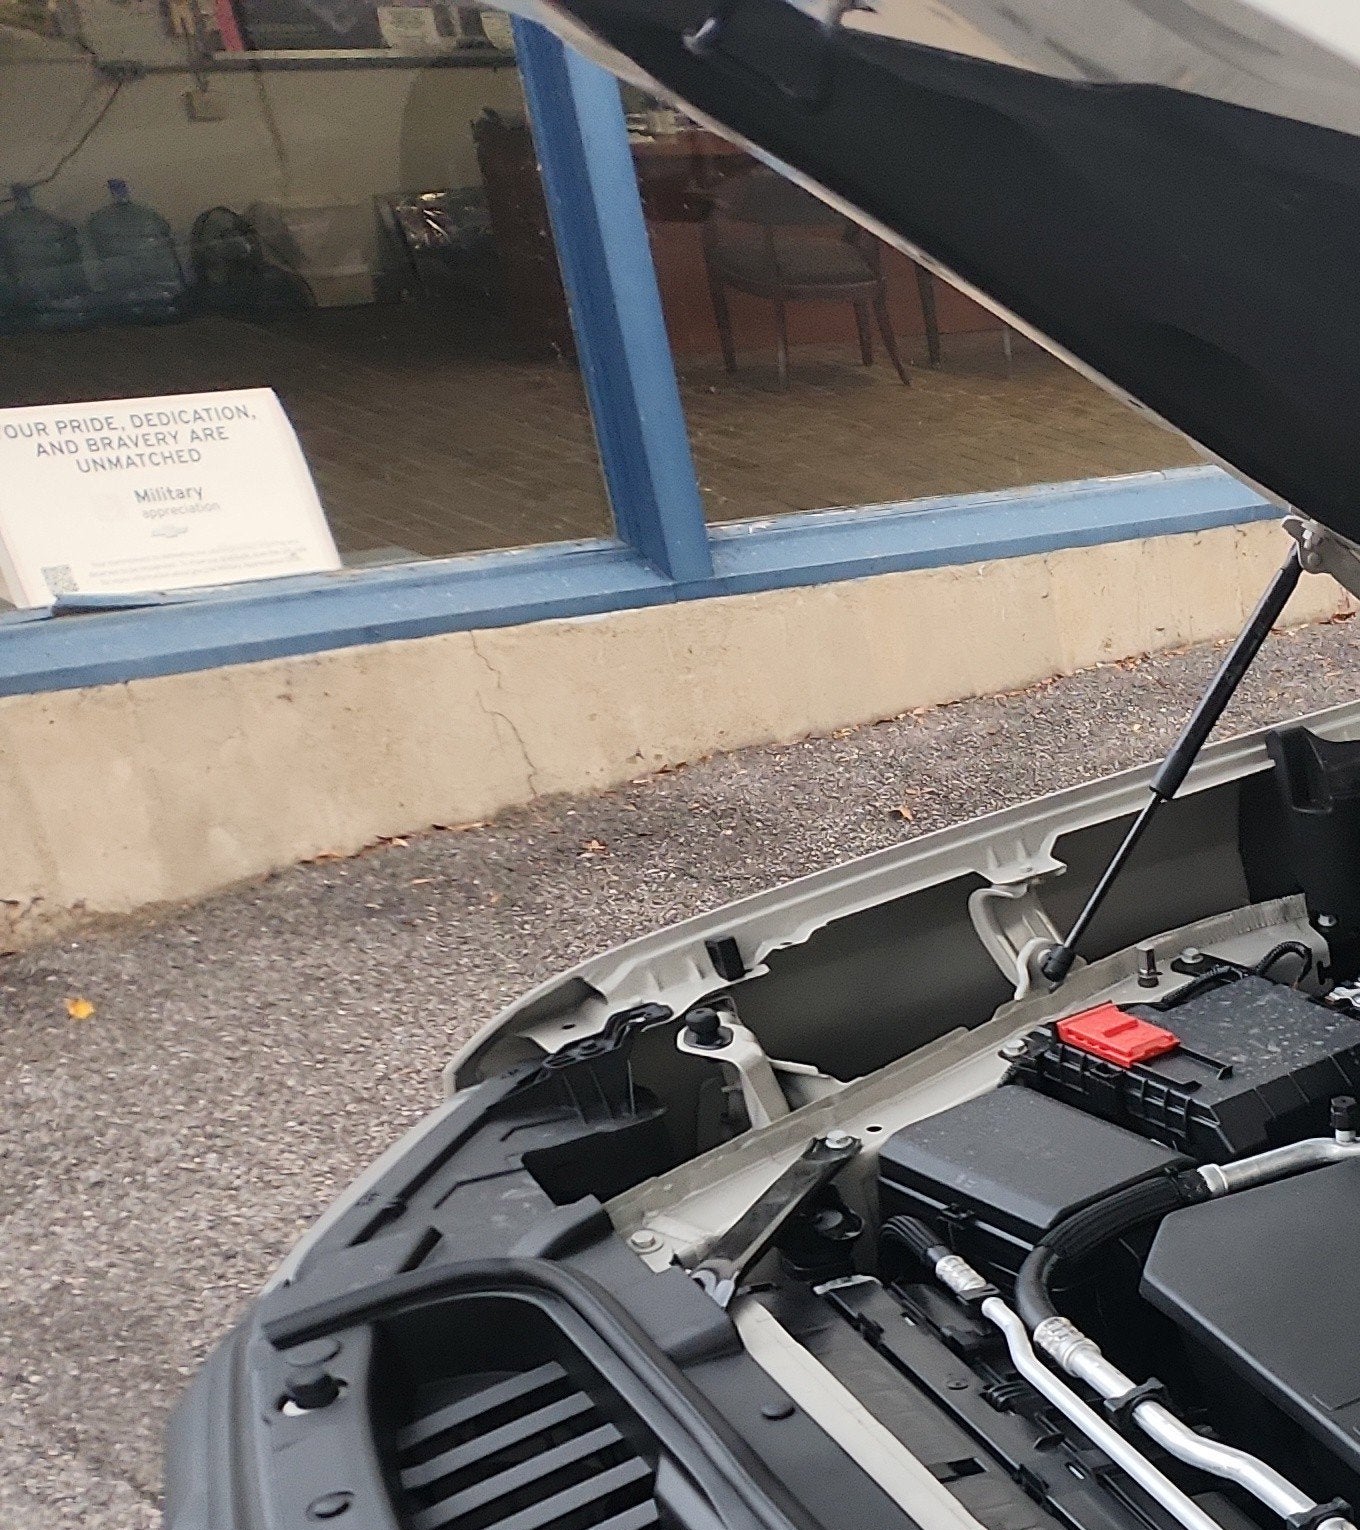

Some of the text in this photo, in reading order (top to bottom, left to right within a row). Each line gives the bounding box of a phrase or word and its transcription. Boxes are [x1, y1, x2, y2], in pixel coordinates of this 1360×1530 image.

[55, 415, 126, 436] PRIDE,
[129, 404, 257, 428] DEDICATION,
[36, 426, 230, 458] AND BRAVERY ARE
[75, 448, 201, 474] UNMATCHED
[133, 486, 203, 504] Military
[142, 501, 221, 520] appreciation
